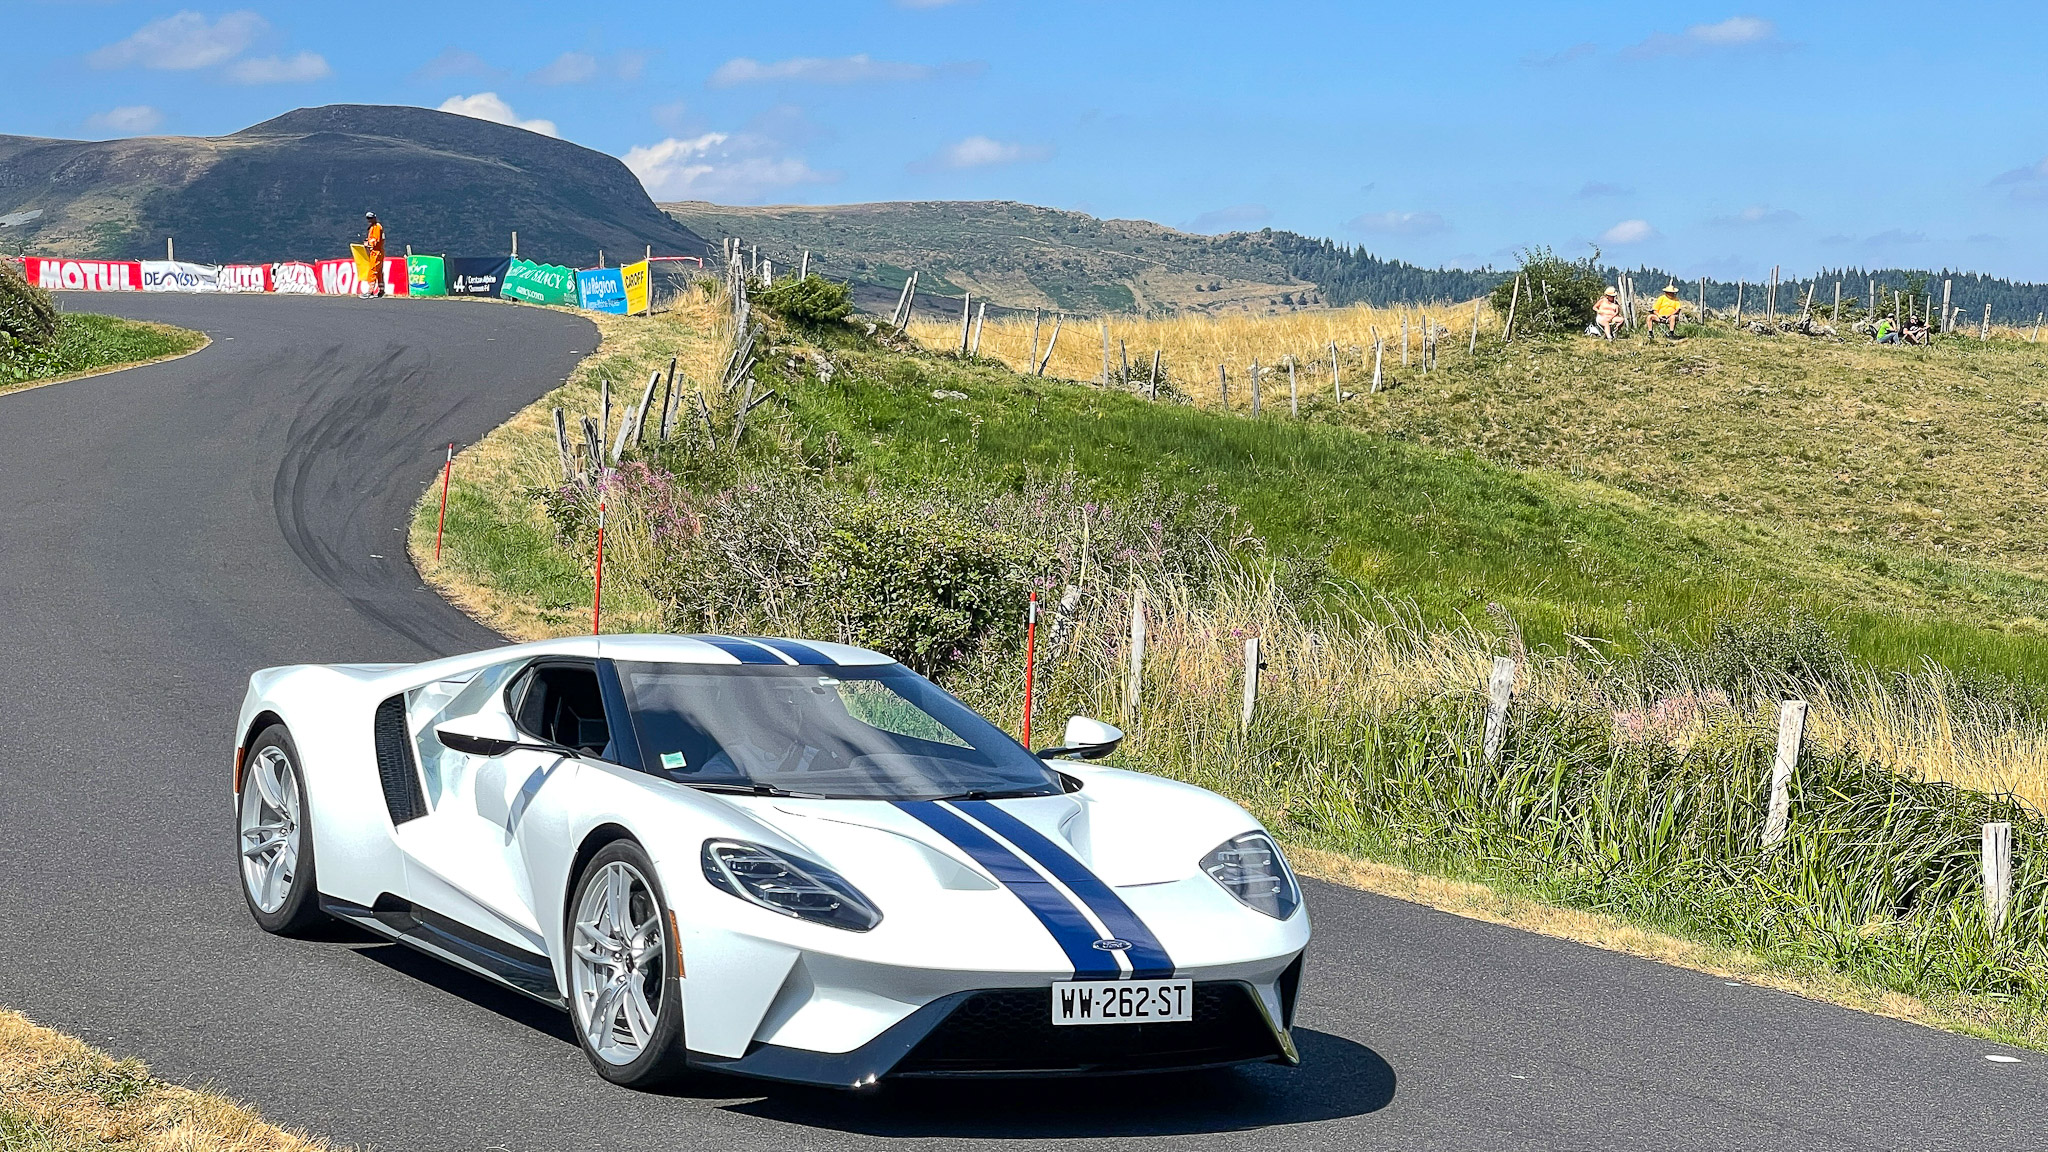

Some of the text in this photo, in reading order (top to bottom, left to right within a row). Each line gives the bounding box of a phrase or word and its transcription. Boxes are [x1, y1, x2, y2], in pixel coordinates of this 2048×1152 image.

[39, 260, 136, 291] MOTUL
[218, 267, 264, 288] AUTO
[531, 270, 564, 289] SANCY
[625, 270, 644, 288] CAROFF
[516, 286, 545, 301] sancy.com
[591, 275, 617, 298] Région
[1061, 985, 1187, 1019] WW-262-ST
